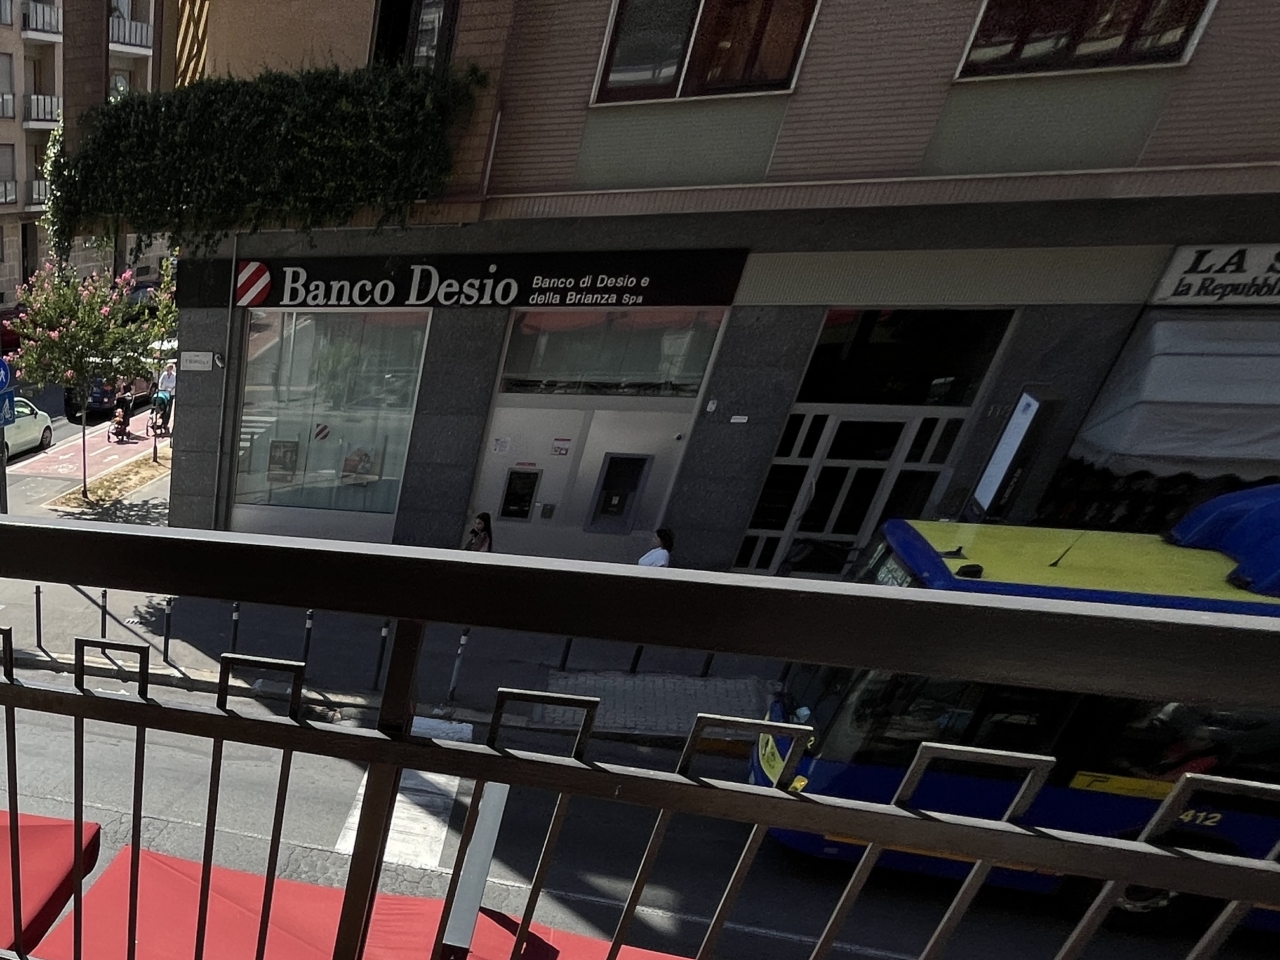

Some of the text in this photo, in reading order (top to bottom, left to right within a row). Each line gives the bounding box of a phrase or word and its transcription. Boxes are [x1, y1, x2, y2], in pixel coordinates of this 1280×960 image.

[1183, 248, 1248, 274] LA
[279, 264, 518, 306] Banco Desio
[532, 275, 650, 288] Banco di Desio e
[1170, 276, 1193, 297] la
[529, 291, 643, 305] della Brianza Spa
